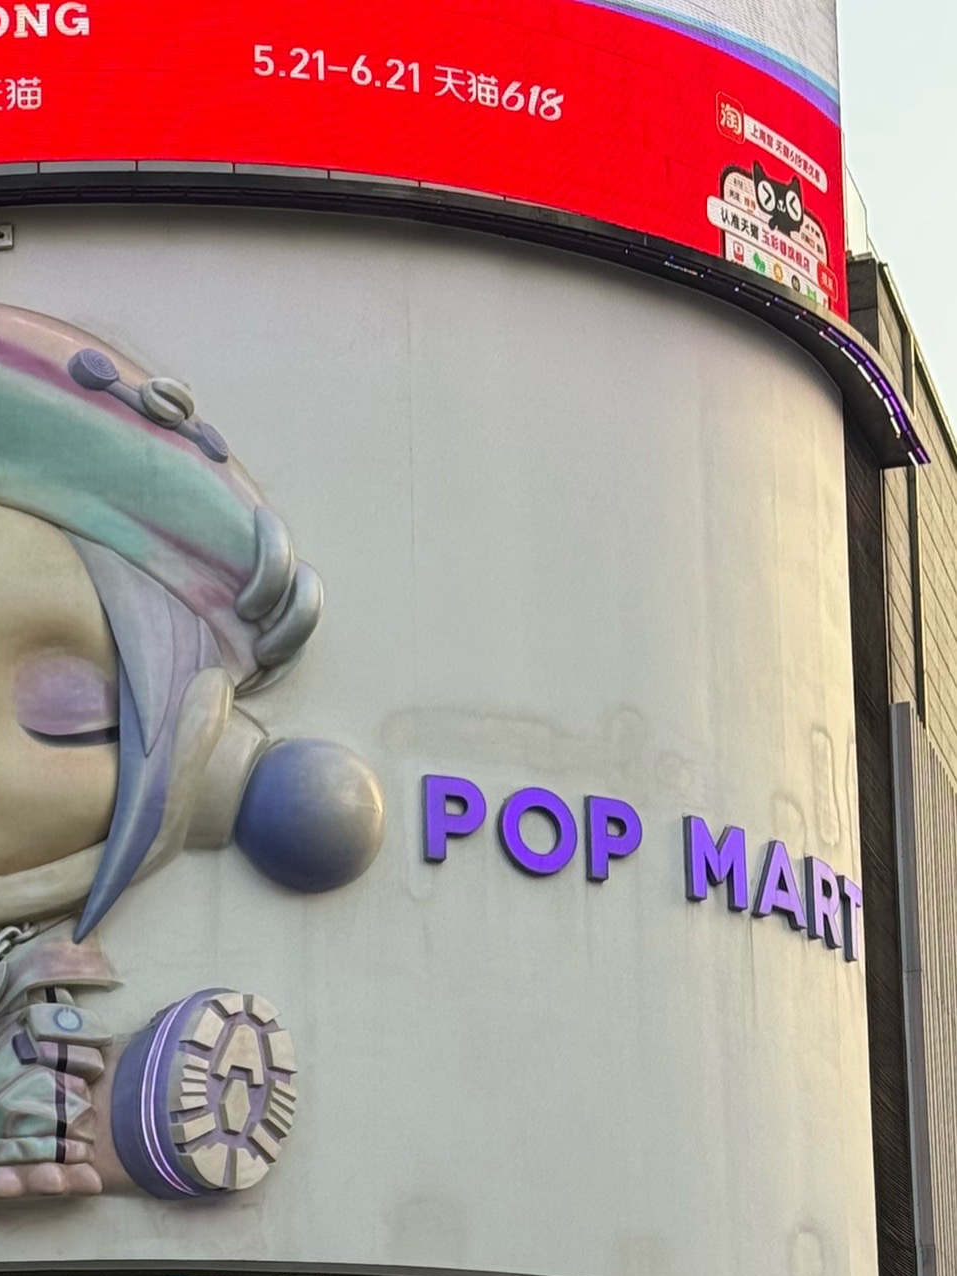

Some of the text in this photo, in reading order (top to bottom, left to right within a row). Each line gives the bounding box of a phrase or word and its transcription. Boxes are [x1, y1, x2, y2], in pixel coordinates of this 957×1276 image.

[434, 63, 564, 122] 天猫618
[720, 102, 742, 135] 淘
[720, 206, 759, 241] 认准天猫
[421, 773, 863, 962] POP MART
